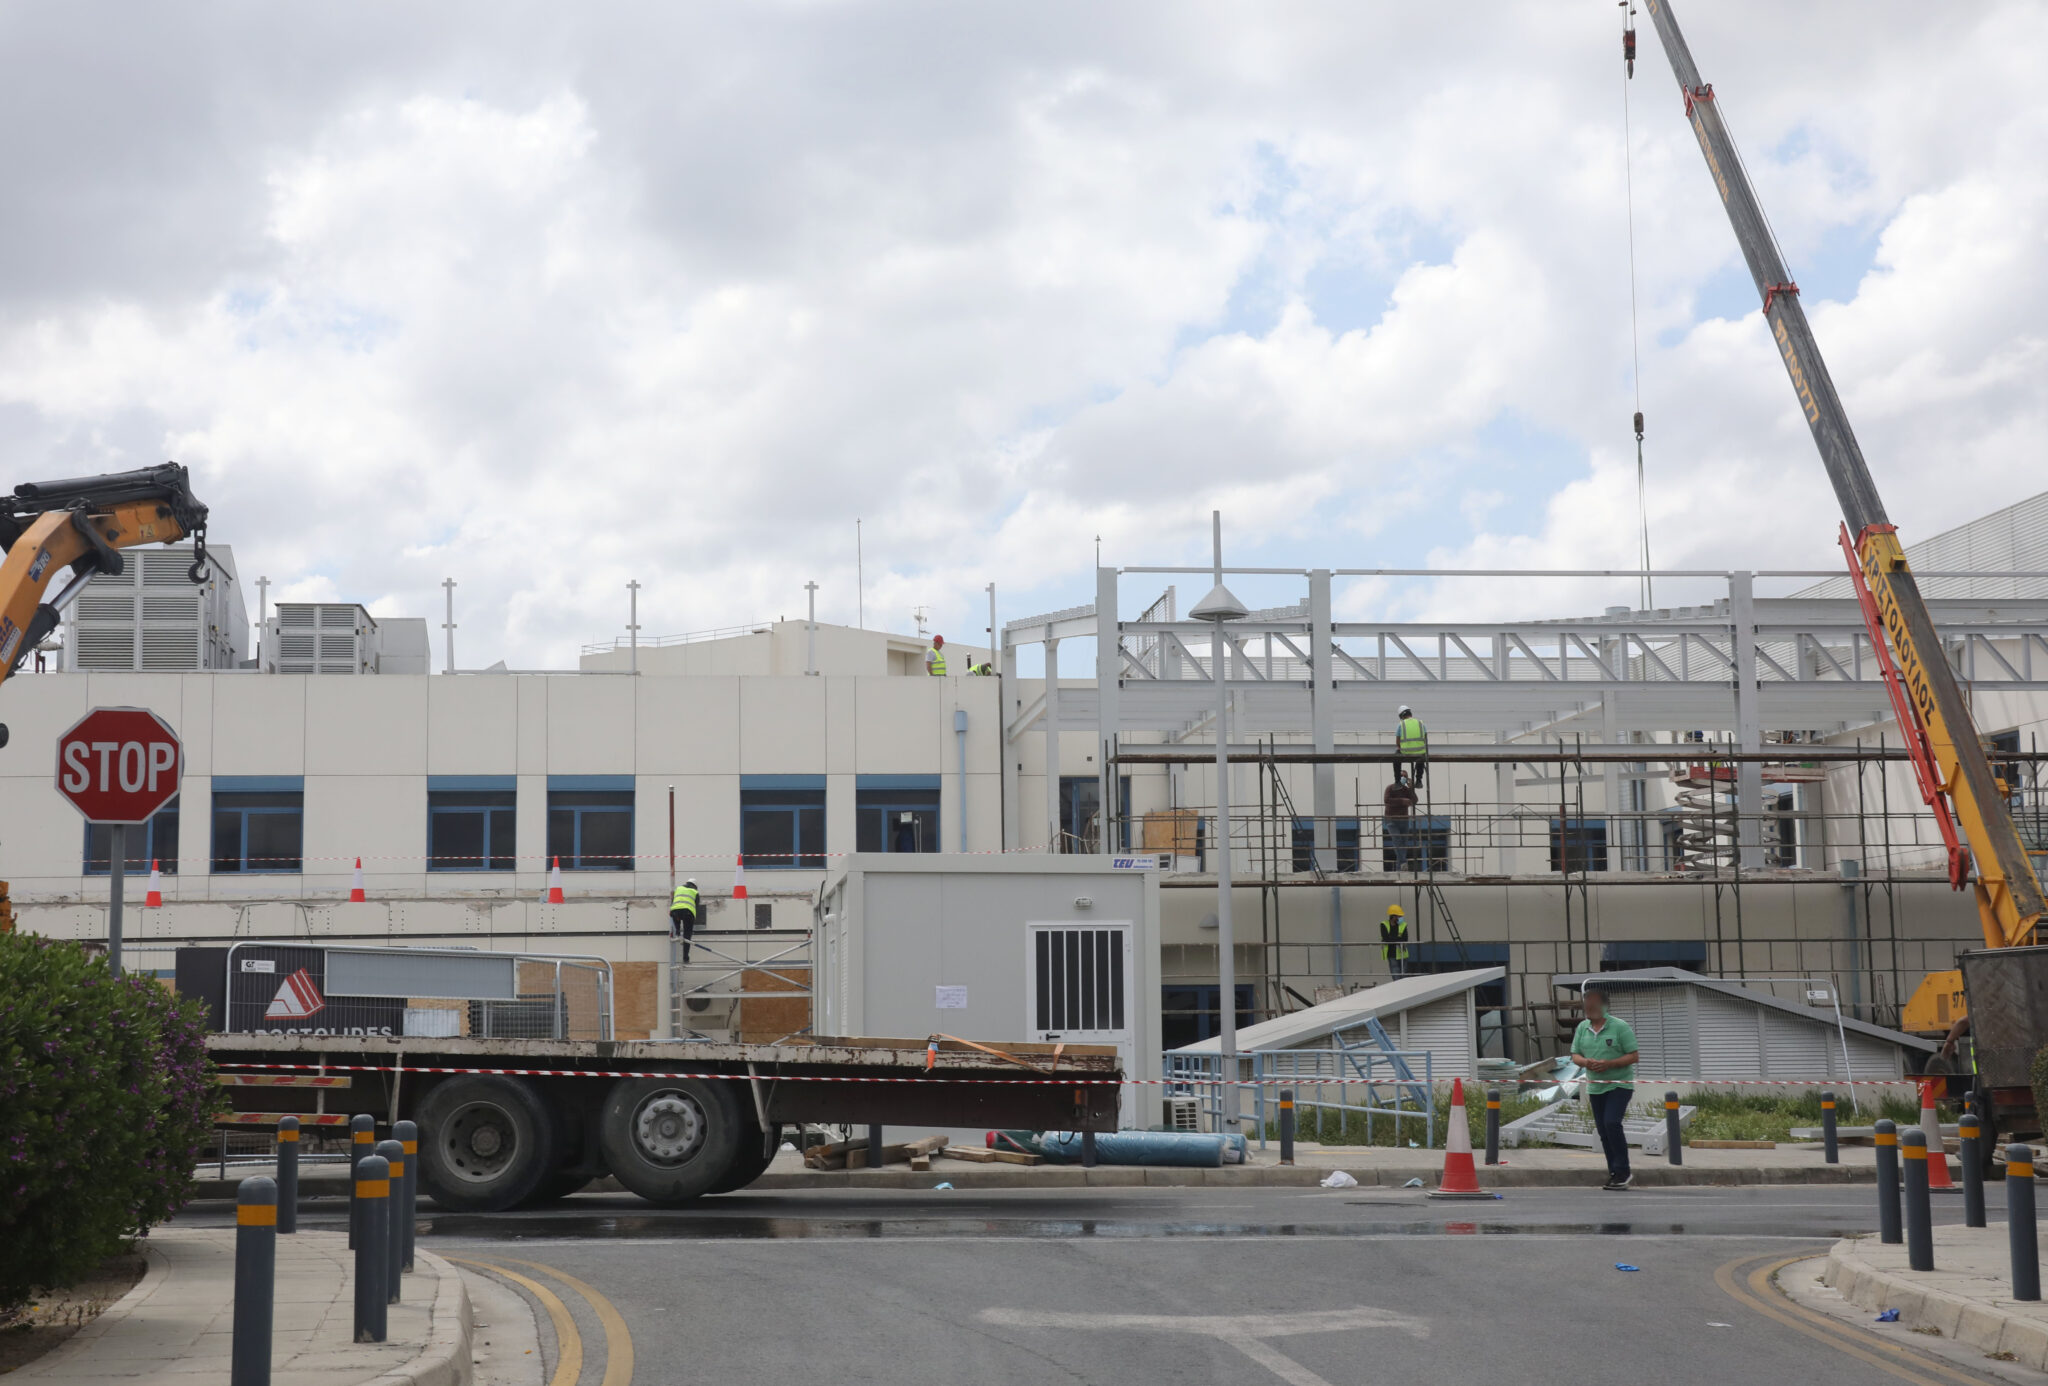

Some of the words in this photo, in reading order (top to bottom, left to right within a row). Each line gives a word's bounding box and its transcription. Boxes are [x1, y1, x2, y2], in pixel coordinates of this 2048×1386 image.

[1785, 341, 1820, 423] 700777
[1865, 547, 1935, 727] ΧΡΙΣΤΟΔΟΥΛΟΣ
[63, 741, 175, 793] STOP
